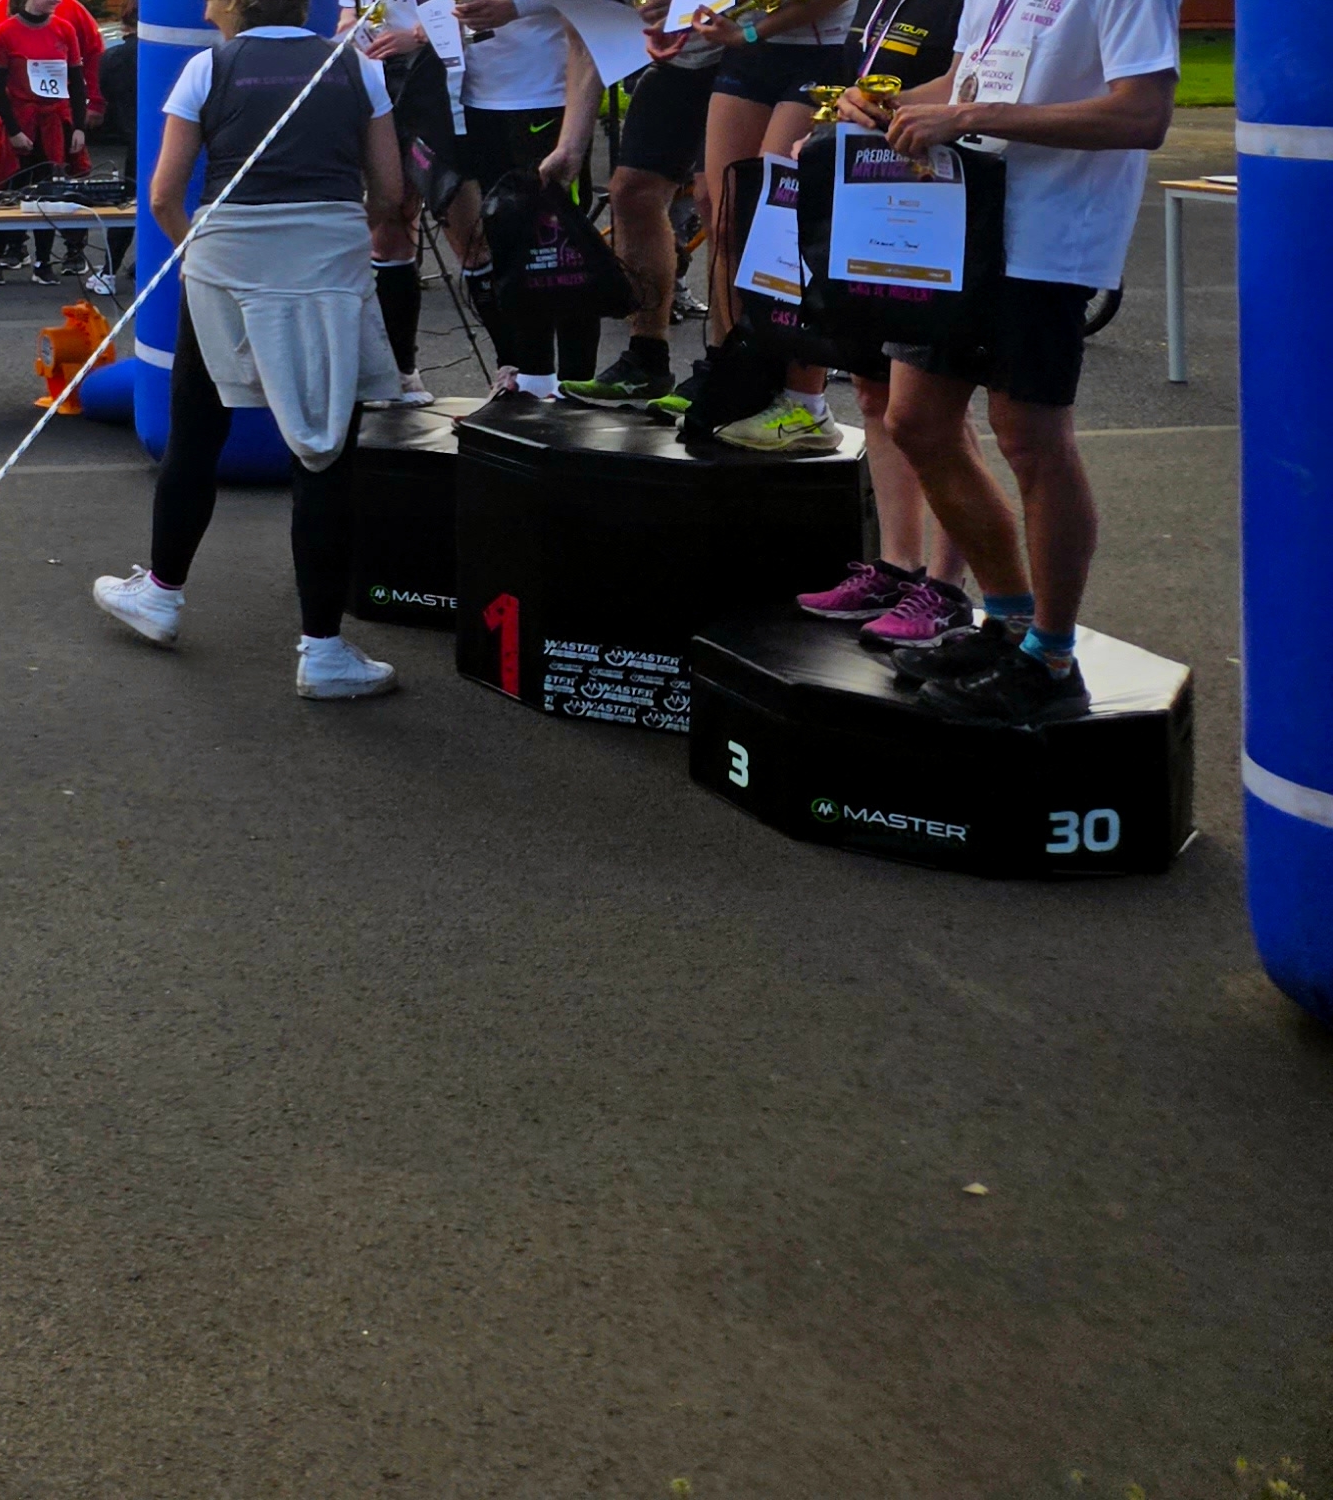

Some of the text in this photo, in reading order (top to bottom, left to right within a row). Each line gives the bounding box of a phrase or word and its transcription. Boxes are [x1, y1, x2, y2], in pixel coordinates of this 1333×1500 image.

[40, 79, 60, 95] 48
[392, 590, 458, 609] MASTE
[484, 592, 520, 696] 1
[728, 740, 749, 787] 3
[843, 805, 967, 841] MASTER
[1045, 808, 1121, 854] 30
